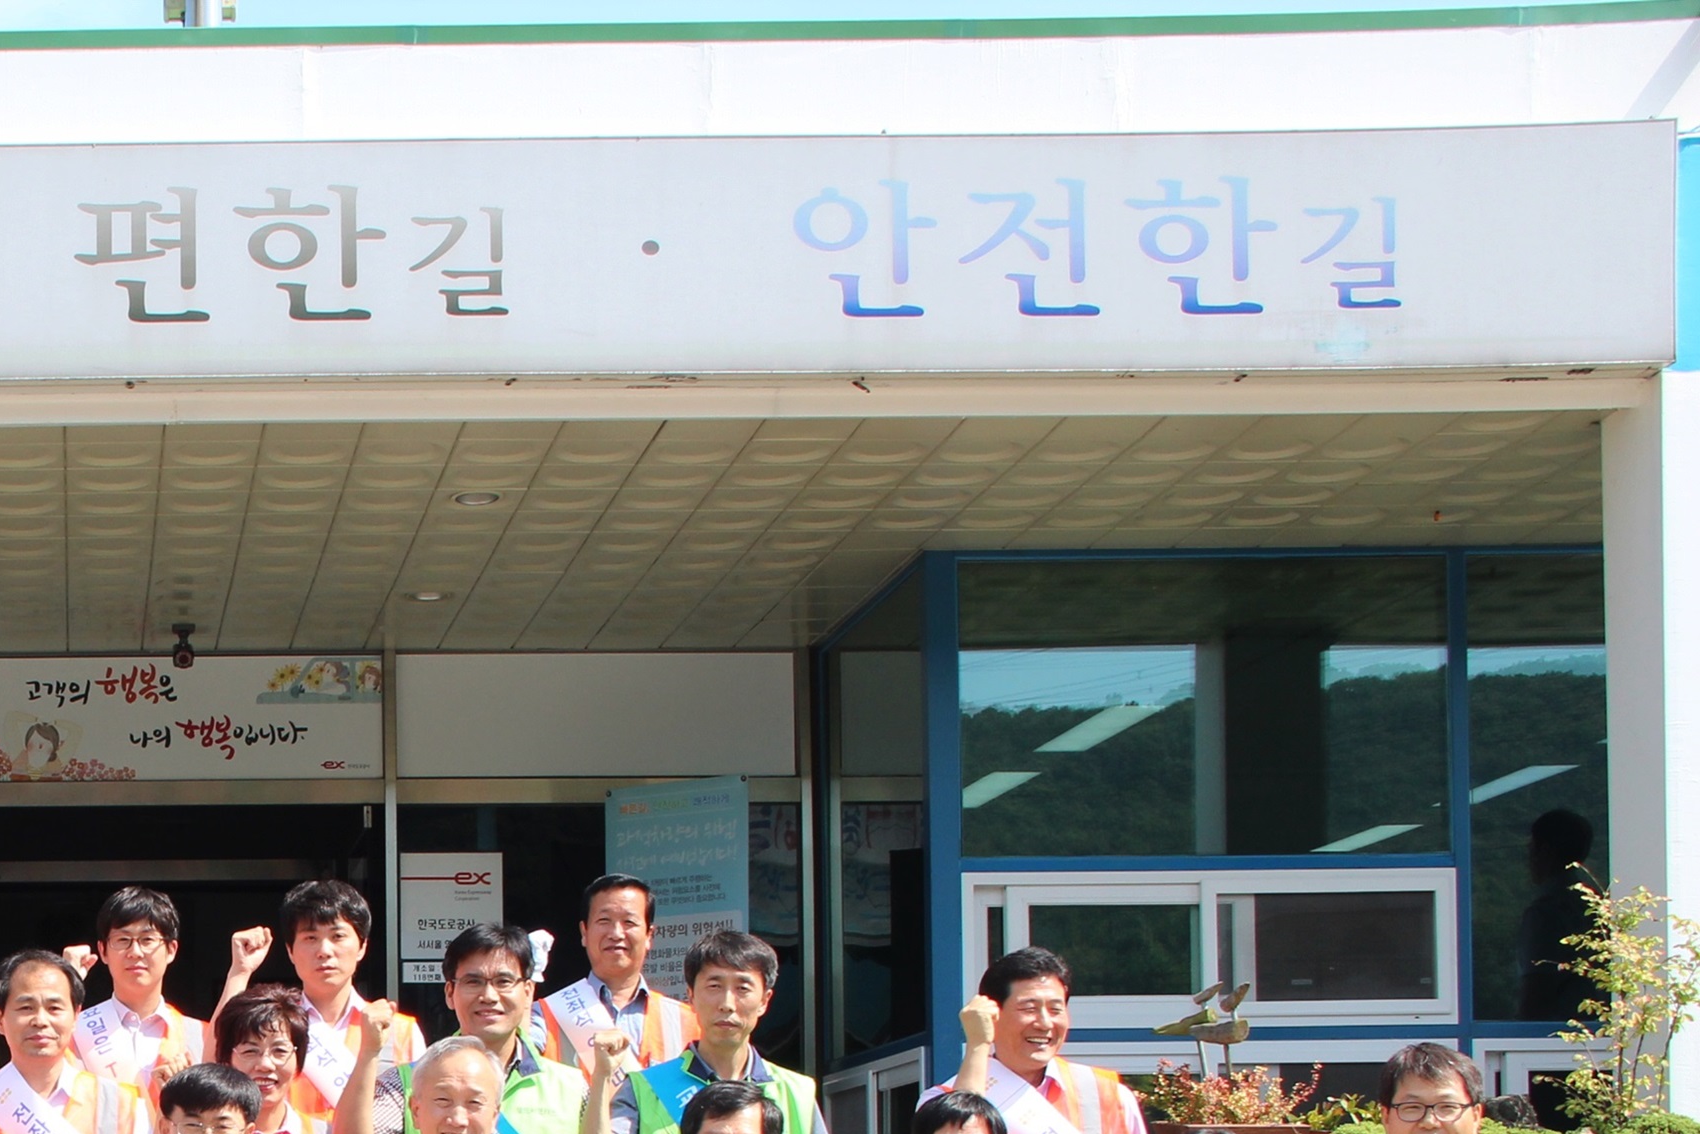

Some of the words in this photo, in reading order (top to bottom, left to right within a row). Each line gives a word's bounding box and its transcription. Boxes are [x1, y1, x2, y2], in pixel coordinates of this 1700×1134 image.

[75, 183, 509, 324] 편한길
[792, 176, 1402, 319] 안전한길
[25, 680, 91, 708] 고객의
[96, 663, 178, 705] 행복은
[130, 723, 171, 748] 나의
[320, 760, 346, 769] ex
[418, 919, 475, 931] 한국도로공사
[651, 923, 688, 940] 차량의
[561, 987, 594, 1028] 전좌석
